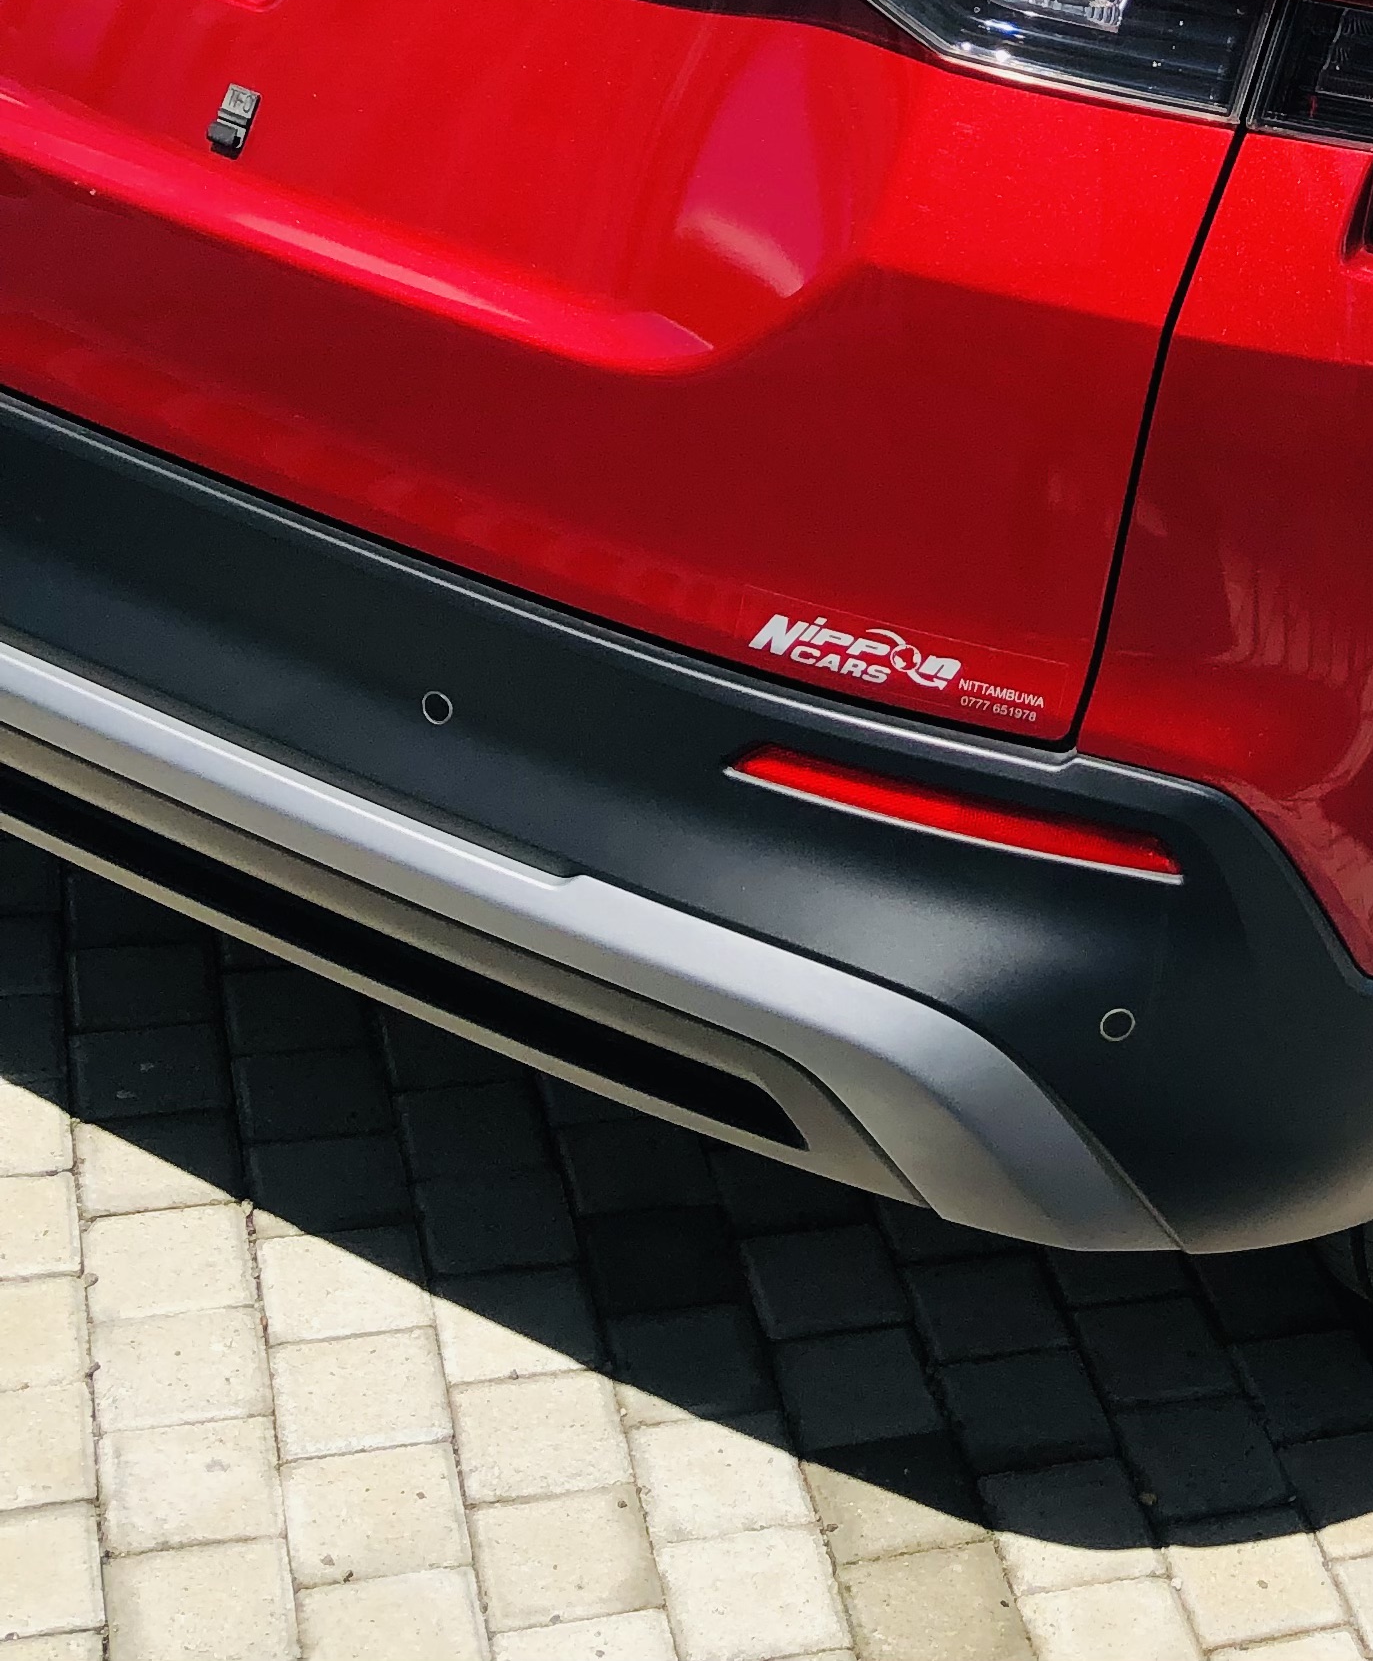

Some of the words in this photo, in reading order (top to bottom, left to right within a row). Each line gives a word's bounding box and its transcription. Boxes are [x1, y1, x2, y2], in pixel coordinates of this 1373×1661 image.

[790, 646, 892, 684] CARS
[958, 678, 1045, 709] NITTAMBUWA
[960, 695, 991, 711] 0777
[992, 703, 1037, 722] 651978
